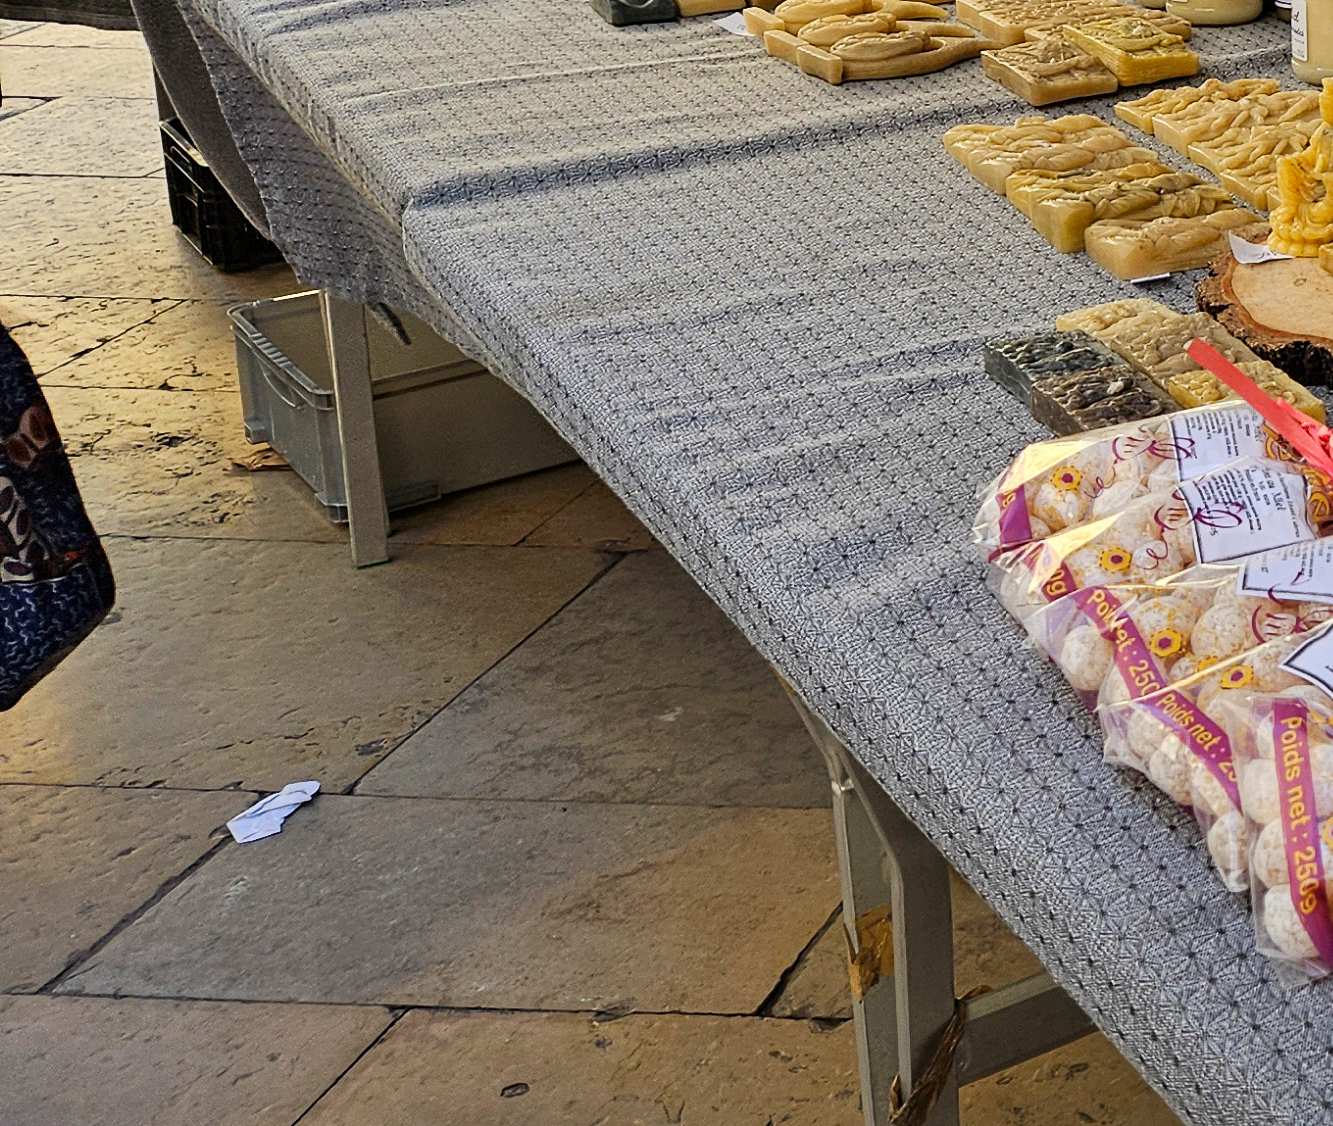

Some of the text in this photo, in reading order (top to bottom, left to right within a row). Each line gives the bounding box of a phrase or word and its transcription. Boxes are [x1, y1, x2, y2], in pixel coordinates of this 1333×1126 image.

[1156, 692, 1195, 729] Poids
[1188, 721, 1219, 751] net
[1281, 715, 1302, 782] Poids
[1286, 786, 1309, 827] net
[1292, 845, 1318, 916] 250g
